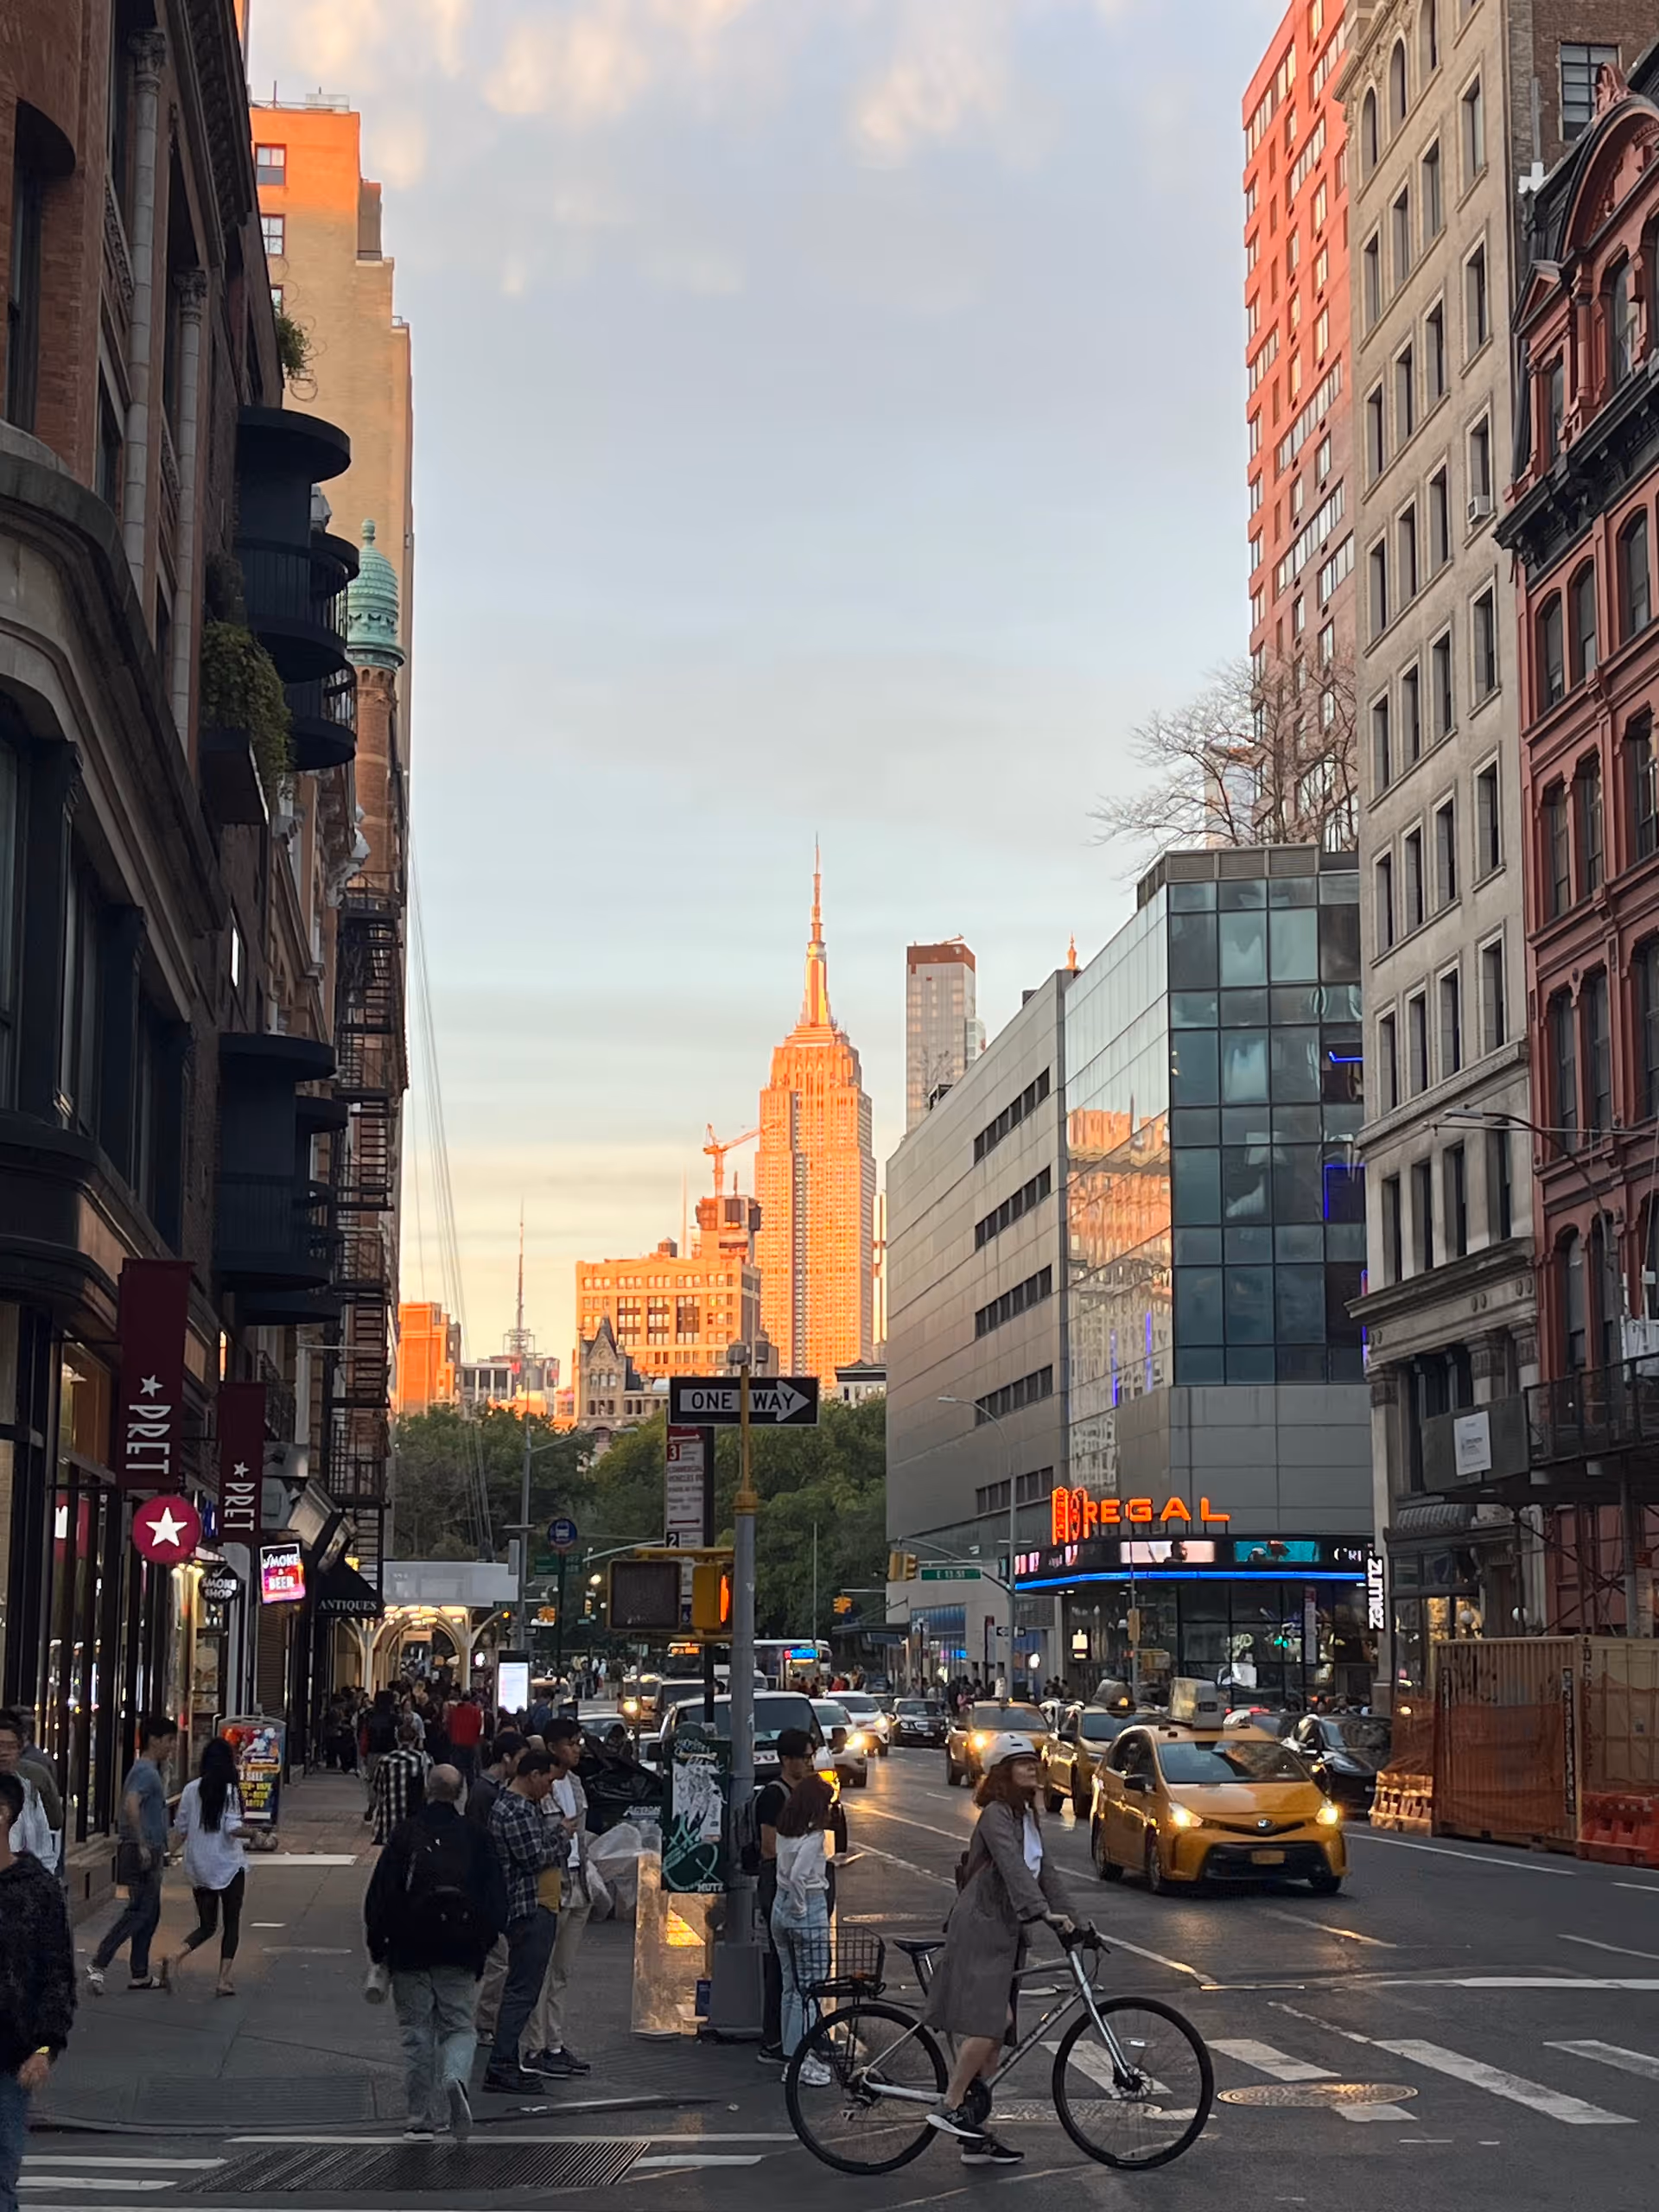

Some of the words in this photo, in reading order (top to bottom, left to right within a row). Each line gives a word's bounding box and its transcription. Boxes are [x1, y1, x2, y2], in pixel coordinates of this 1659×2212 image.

[691, 1391, 733, 1410] ONE
[753, 1391, 796, 1410] WAY
[125, 1404, 172, 1475] PRET
[669, 1445, 678, 1461] 3
[223, 1482, 257, 1532] PRET
[1085, 1496, 1230, 1524] REGAL
[668, 1533, 677, 1548] 2
[263, 1553, 300, 1569] SMOKE
[201, 1578, 238, 1591] SMOKE
[268, 1575, 296, 1591] BEER
[204, 1588, 233, 1599] SHOP
[1367, 1557, 1385, 1630] zumiez
[318, 1599, 378, 1611] ANTIQUES
